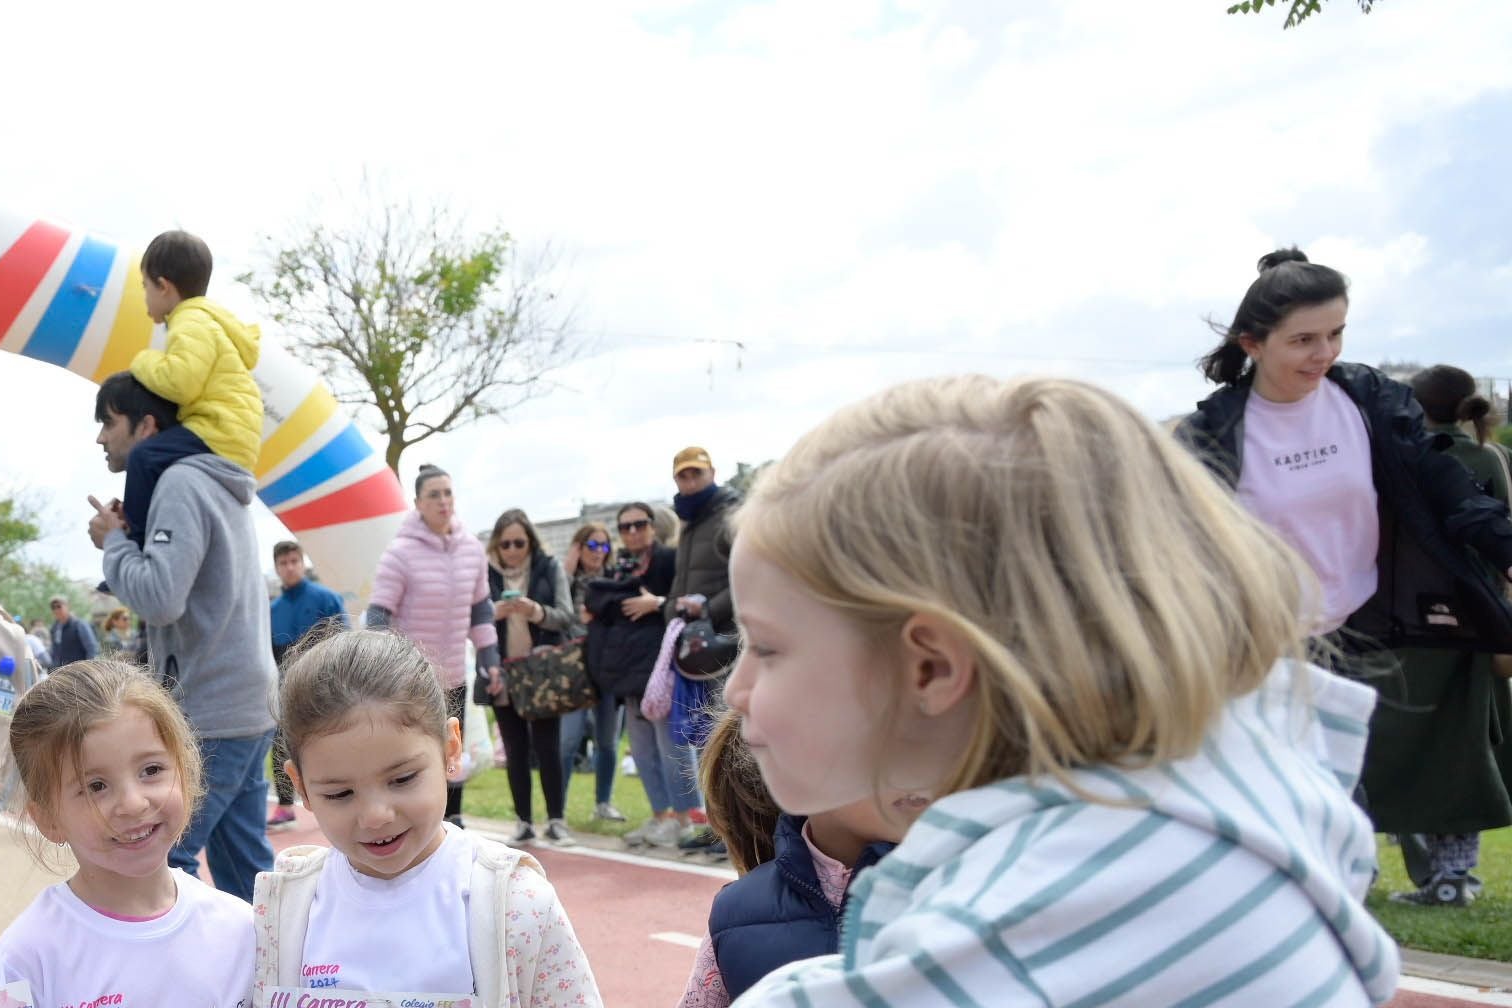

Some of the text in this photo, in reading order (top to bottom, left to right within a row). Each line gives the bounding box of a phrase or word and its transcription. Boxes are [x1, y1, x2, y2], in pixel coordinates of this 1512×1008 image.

[1274, 444, 1338, 467] KAOTIKO
[309, 978, 340, 988] 2024
[270, 992, 291, 1008] III
